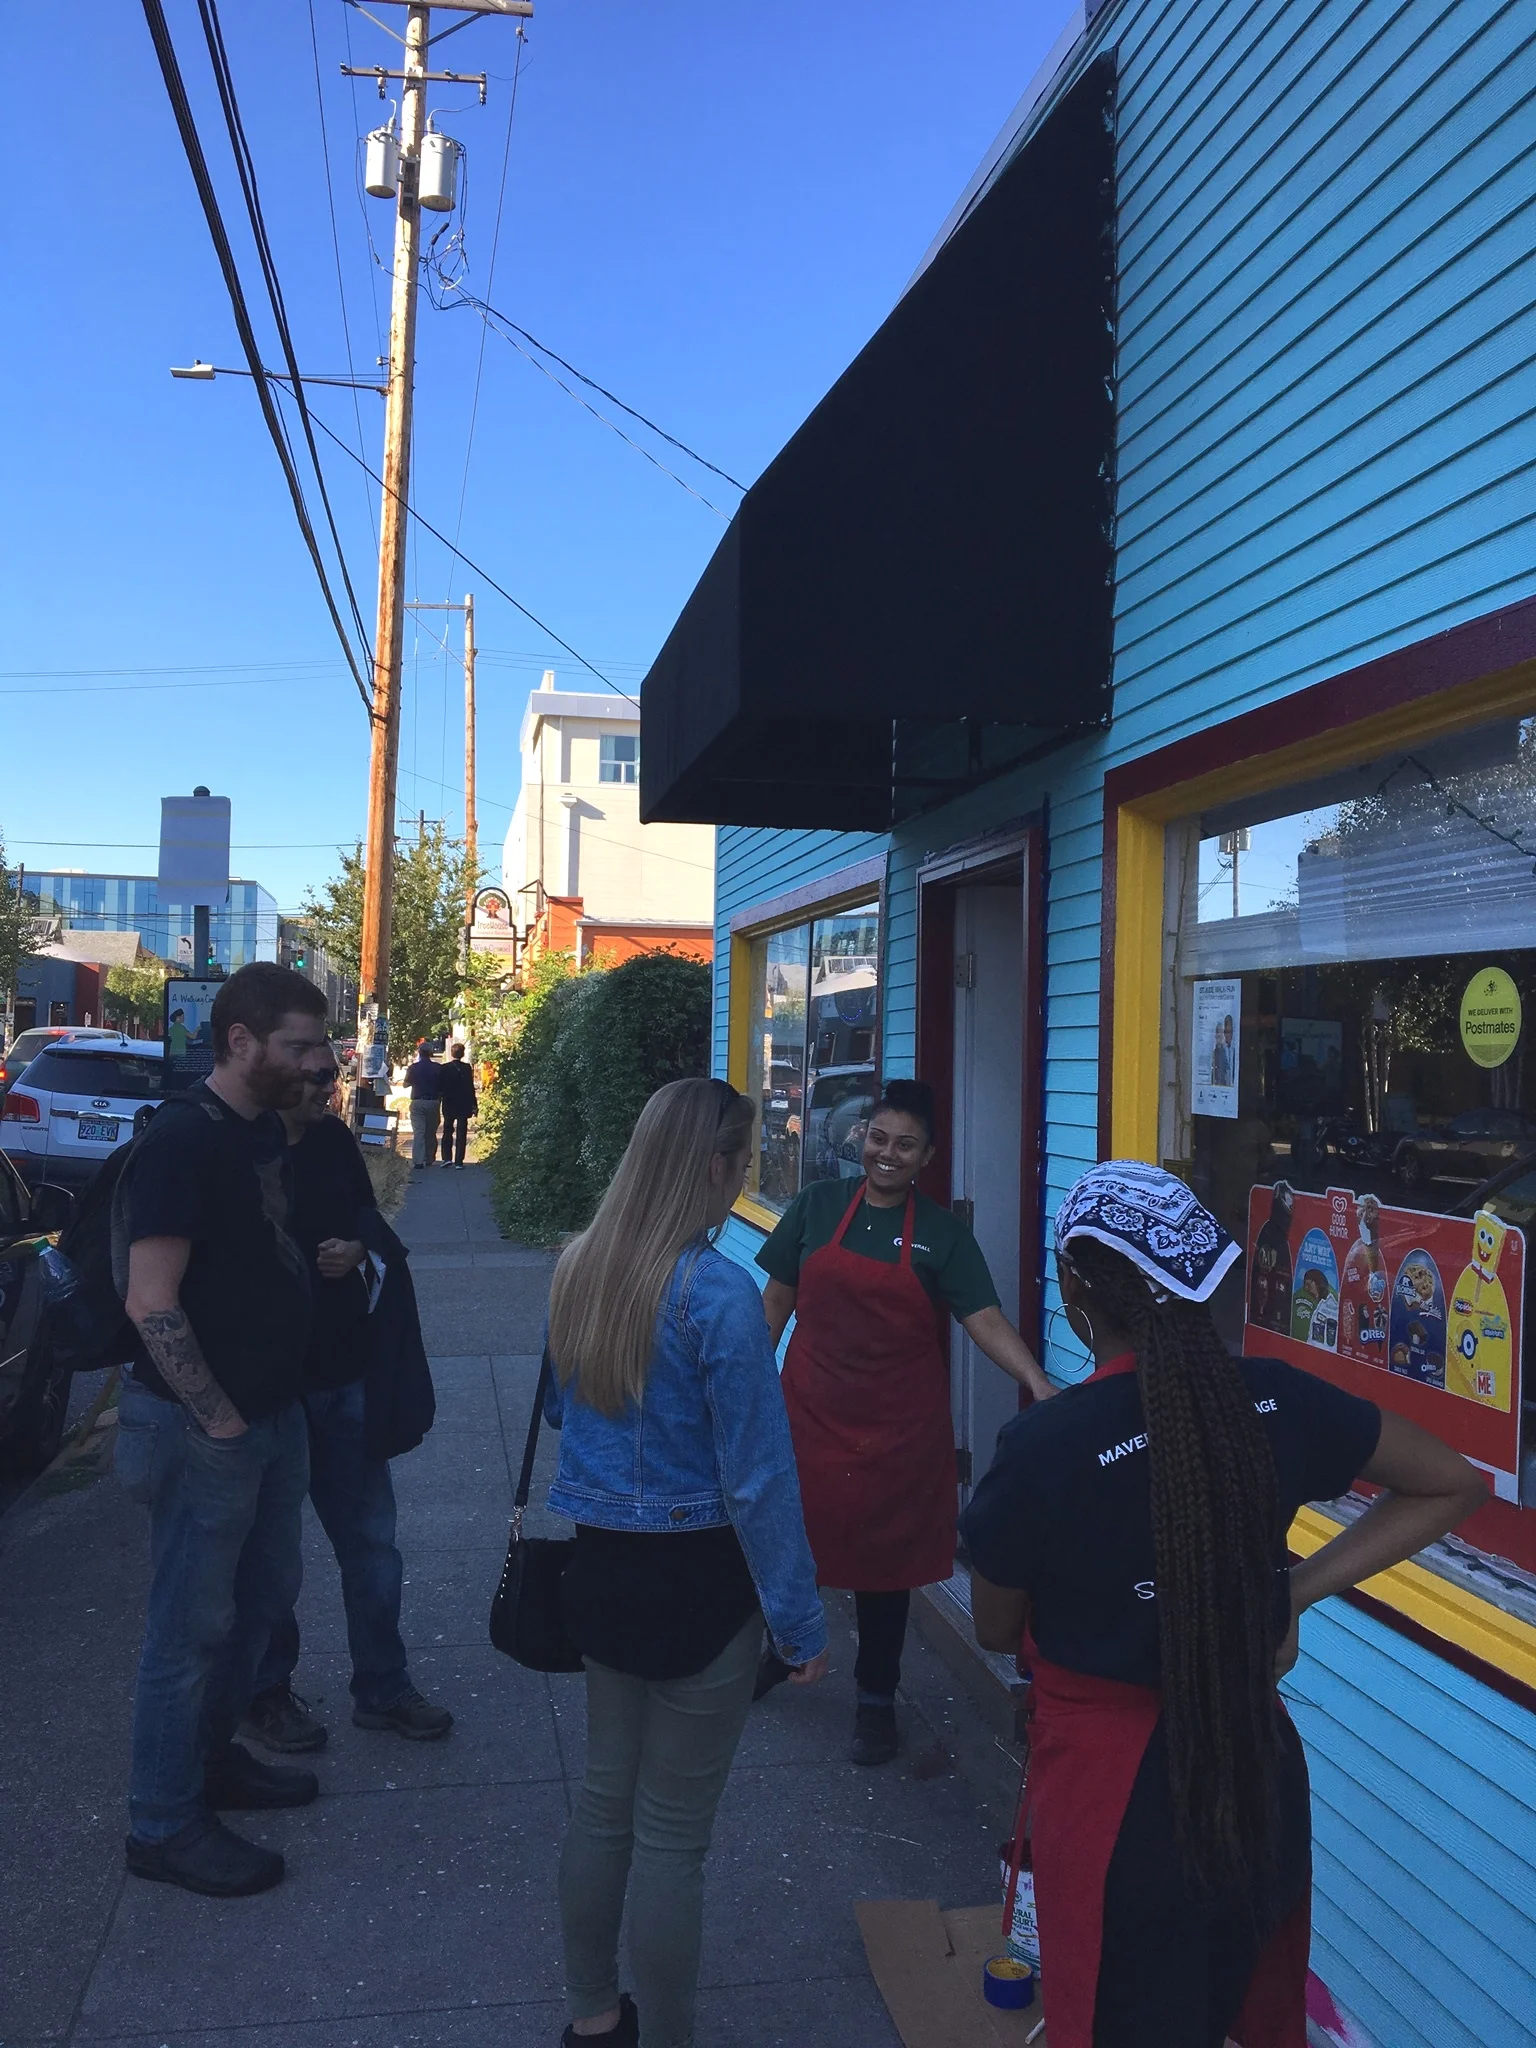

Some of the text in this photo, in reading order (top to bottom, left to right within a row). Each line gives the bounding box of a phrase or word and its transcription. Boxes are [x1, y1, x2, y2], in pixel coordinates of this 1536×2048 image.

[172, 994, 177, 1002] A
[180, 994, 204, 1005] Walking
[1477, 1008, 1499, 1016] DELIVER
[1500, 1007, 1513, 1015] WITH
[1465, 1021, 1516, 1035] Postmates
[80, 1124, 117, 1137] 920 EVK
[1331, 1213, 1347, 1227] GOOD
[1329, 1225, 1349, 1239] HUMOR
[1360, 1328, 1386, 1342] OREO
[1478, 1375, 1492, 1395] ME
[1013, 1908, 1033, 1920] URAL
[1013, 1915, 1035, 1928] GURT
